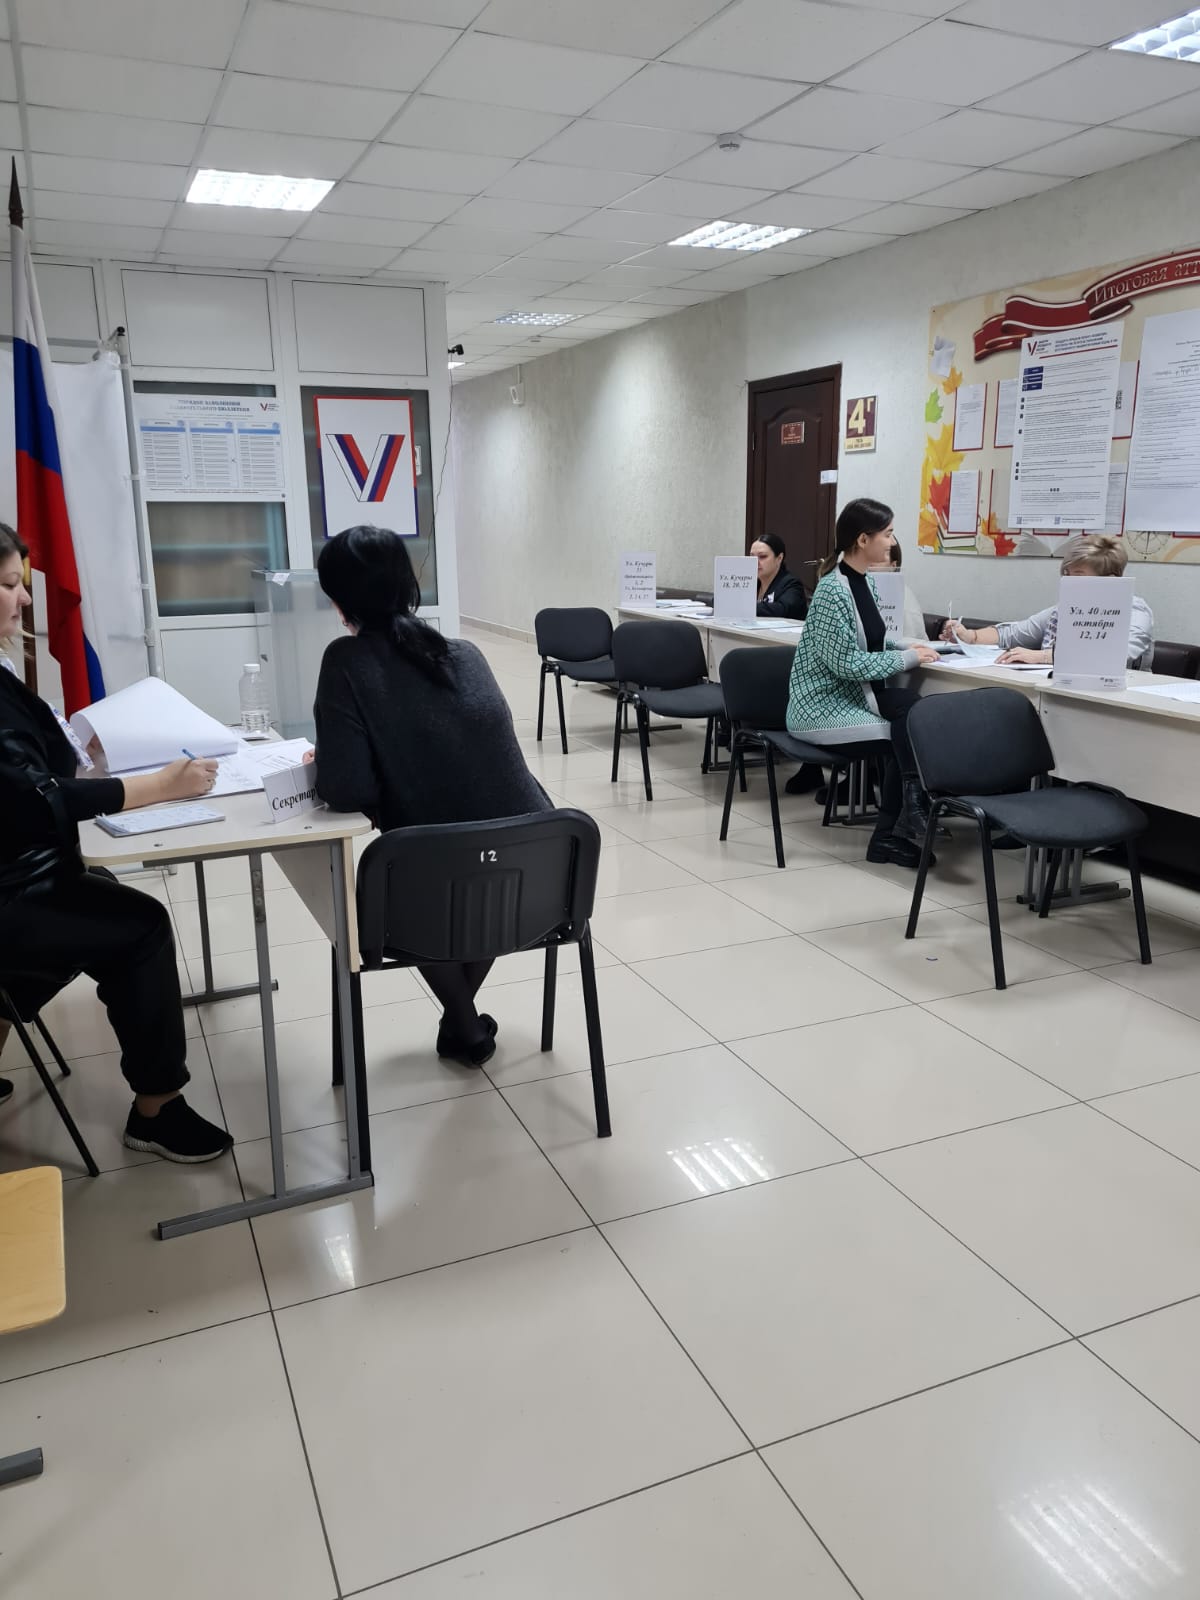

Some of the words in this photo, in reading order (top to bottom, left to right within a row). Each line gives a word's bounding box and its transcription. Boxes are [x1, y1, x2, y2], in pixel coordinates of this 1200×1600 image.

[1094, 267, 1168, 304] Итоговая
[730, 574, 753, 582] Кучуры
[1069, 606, 1085, 616] Ул.
[1088, 606, 1100, 616] 40
[1100, 607, 1121, 616] лет
[1072, 619, 1115, 630] октября
[1079, 630, 1092, 640] 12,
[1095, 630, 1108, 640] 14
[480, 849, 497, 863] 12
